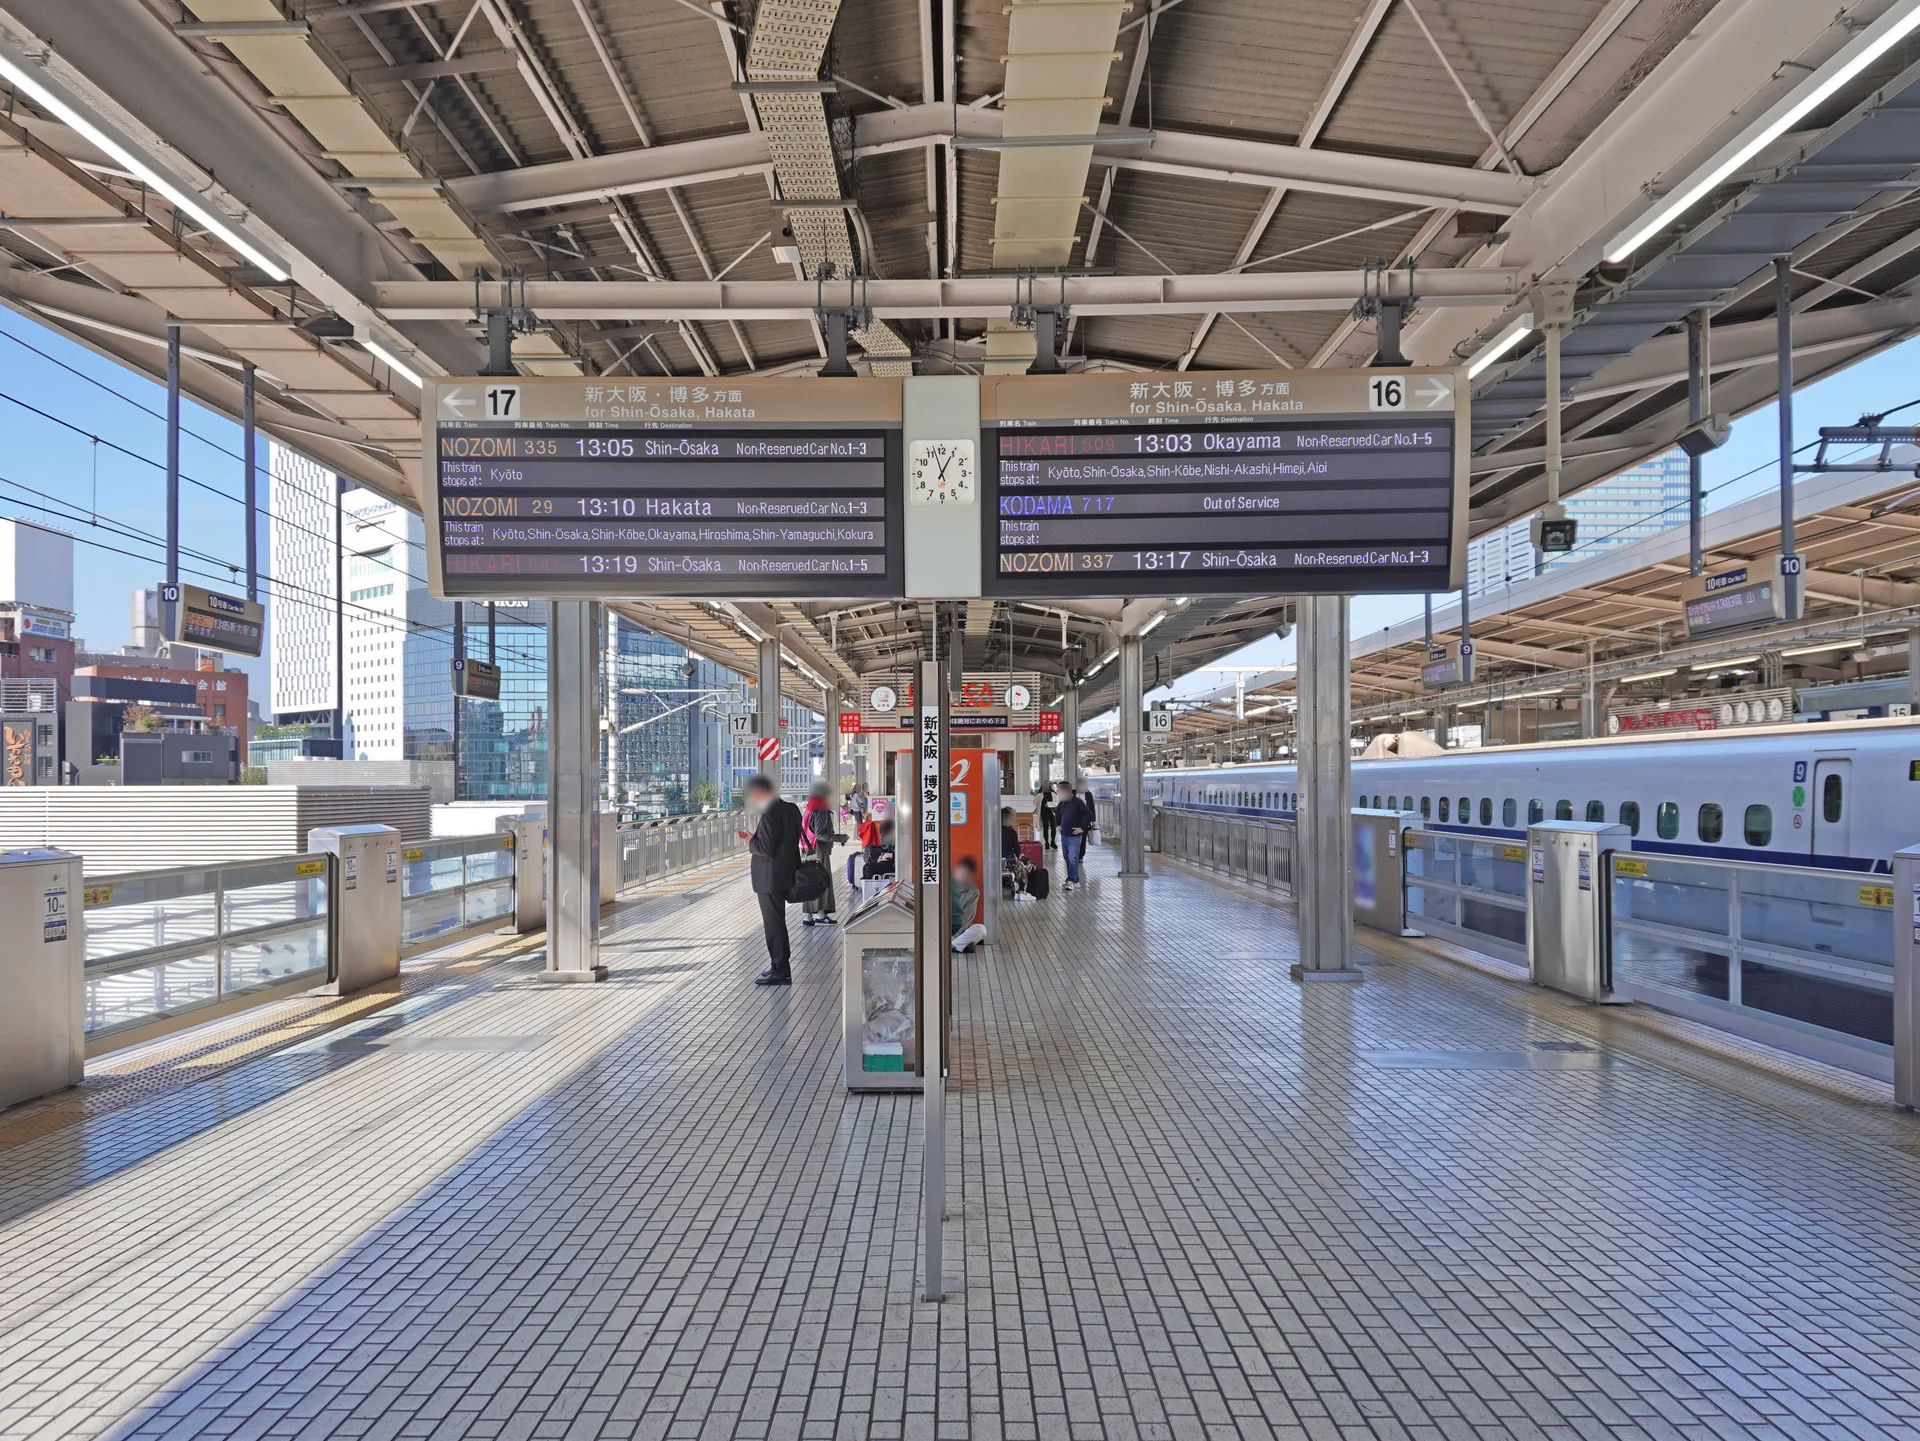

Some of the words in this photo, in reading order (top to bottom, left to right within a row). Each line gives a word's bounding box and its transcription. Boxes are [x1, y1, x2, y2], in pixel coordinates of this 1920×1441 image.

[1372, 380, 1402, 407] 16
[488, 389, 516, 416] 17
[1130, 402, 1150, 414] for
[1156, 398, 1246, 413] Shin-Ōsaka,
[1252, 399, 1303, 412] Hakata
[585, 406, 605, 418] for
[611, 403, 700, 420] Shin-Ōsaka,
[705, 406, 755, 418] Hakata
[442, 437, 516, 456] NOZOMI
[525, 440, 556, 454] 335
[576, 438, 634, 456] 13:05
[645, 440, 719, 456] Shin-Ōsaka
[810, 442, 828, 455] Car
[1000, 436, 1074, 456] HIKARI
[1083, 438, 1114, 452] 509
[1134, 434, 1192, 453] 13:03
[1203, 434, 1281, 452] Okayama
[1373, 434, 1392, 446] Car
[442, 461, 461, 473] This
[462, 461, 482, 473] train
[1000, 460, 1019, 472] This
[1020, 460, 1039, 472] train
[442, 475, 467, 487] stops
[468, 475, 482, 486] at:
[490, 469, 522, 482] Kyōto
[1000, 474, 1025, 486] stops
[1026, 474, 1039, 485] at:
[442, 497, 517, 517] NOZOMI
[532, 500, 553, 514] 29
[577, 498, 635, 516] 13:10
[646, 499, 712, 516] Hakata
[811, 502, 829, 515] Car
[1000, 496, 1073, 516] KODAMA
[1082, 497, 1114, 512] 717
[1204, 497, 1222, 510] Out
[1224, 496, 1235, 509] of
[1238, 496, 1280, 509] Service
[444, 521, 463, 532] This
[464, 521, 483, 532] train
[1000, 520, 1019, 532] This
[1020, 520, 1039, 532] train
[445, 535, 469, 546] stops
[471, 535, 484, 546] at:
[1000, 534, 1025, 546] stops
[1026, 534, 1039, 545] at:
[446, 554, 520, 573] HIKARI
[580, 556, 637, 573] 13:19
[648, 556, 721, 572] Shin-Ōsaka
[812, 559, 830, 571] Car
[1000, 552, 1074, 572] NOZOMI
[1082, 554, 1114, 568] 337
[1134, 552, 1191, 569] 13:17
[1202, 550, 1277, 567] Shin-Ōsaka
[1370, 551, 1389, 563] Car
[1783, 559, 1799, 573] 10
[163, 587, 177, 600] 10
[1464, 645, 1470, 654] 9
[455, 661, 462, 669] 9
[1893, 708, 1906, 716] 15
[734, 718, 747, 730] 17
[1154, 714, 1167, 727] 16
[1796, 763, 1804, 780] 9
[389, 855, 392, 864] 9
[1535, 853, 1538, 863] 9
[1580, 858, 1586, 869] 10
[347, 860, 352, 870] 10
[47, 897, 58, 913] 10
